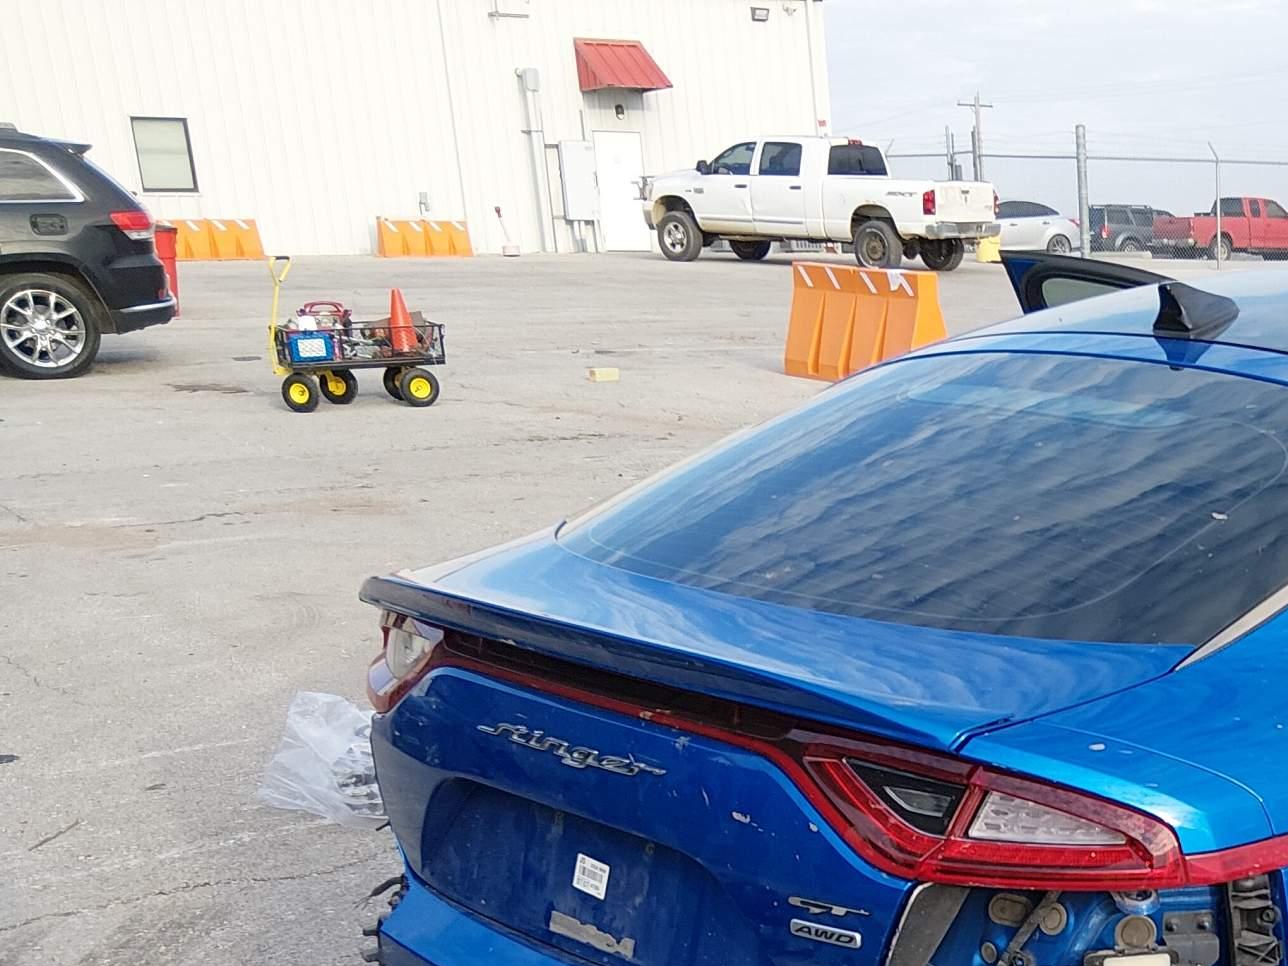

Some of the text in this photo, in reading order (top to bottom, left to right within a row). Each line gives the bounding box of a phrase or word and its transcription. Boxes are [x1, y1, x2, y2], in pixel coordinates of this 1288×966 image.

[476, 722, 668, 776] Stinger
[787, 896, 870, 917] GT
[795, 926, 855, 945] AWD
